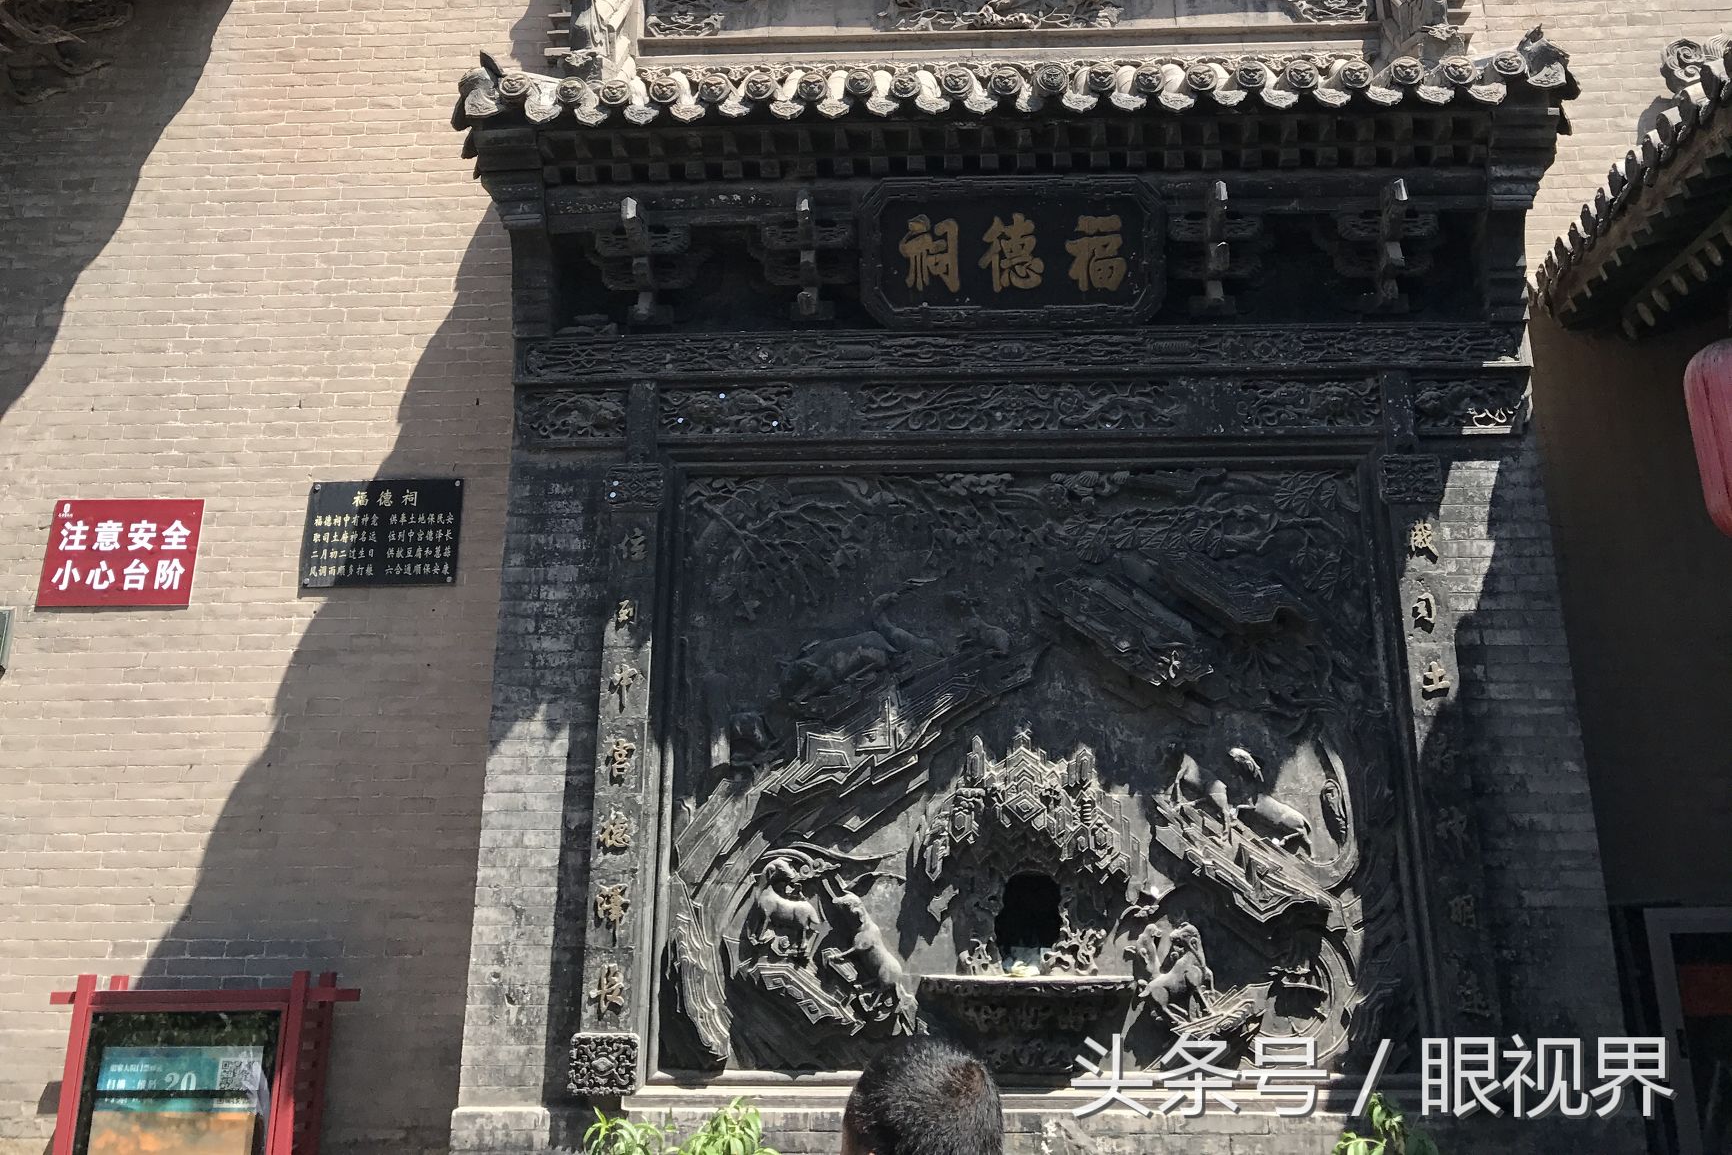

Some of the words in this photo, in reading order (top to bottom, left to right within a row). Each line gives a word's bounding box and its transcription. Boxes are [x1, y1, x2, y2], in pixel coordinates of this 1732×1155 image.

[351, 489, 418, 507] 福德祠
[58, 519, 191, 551] 注意安全
[310, 547, 374, 560] 二月初二过生日
[51, 558, 186, 591] 小心台阶
